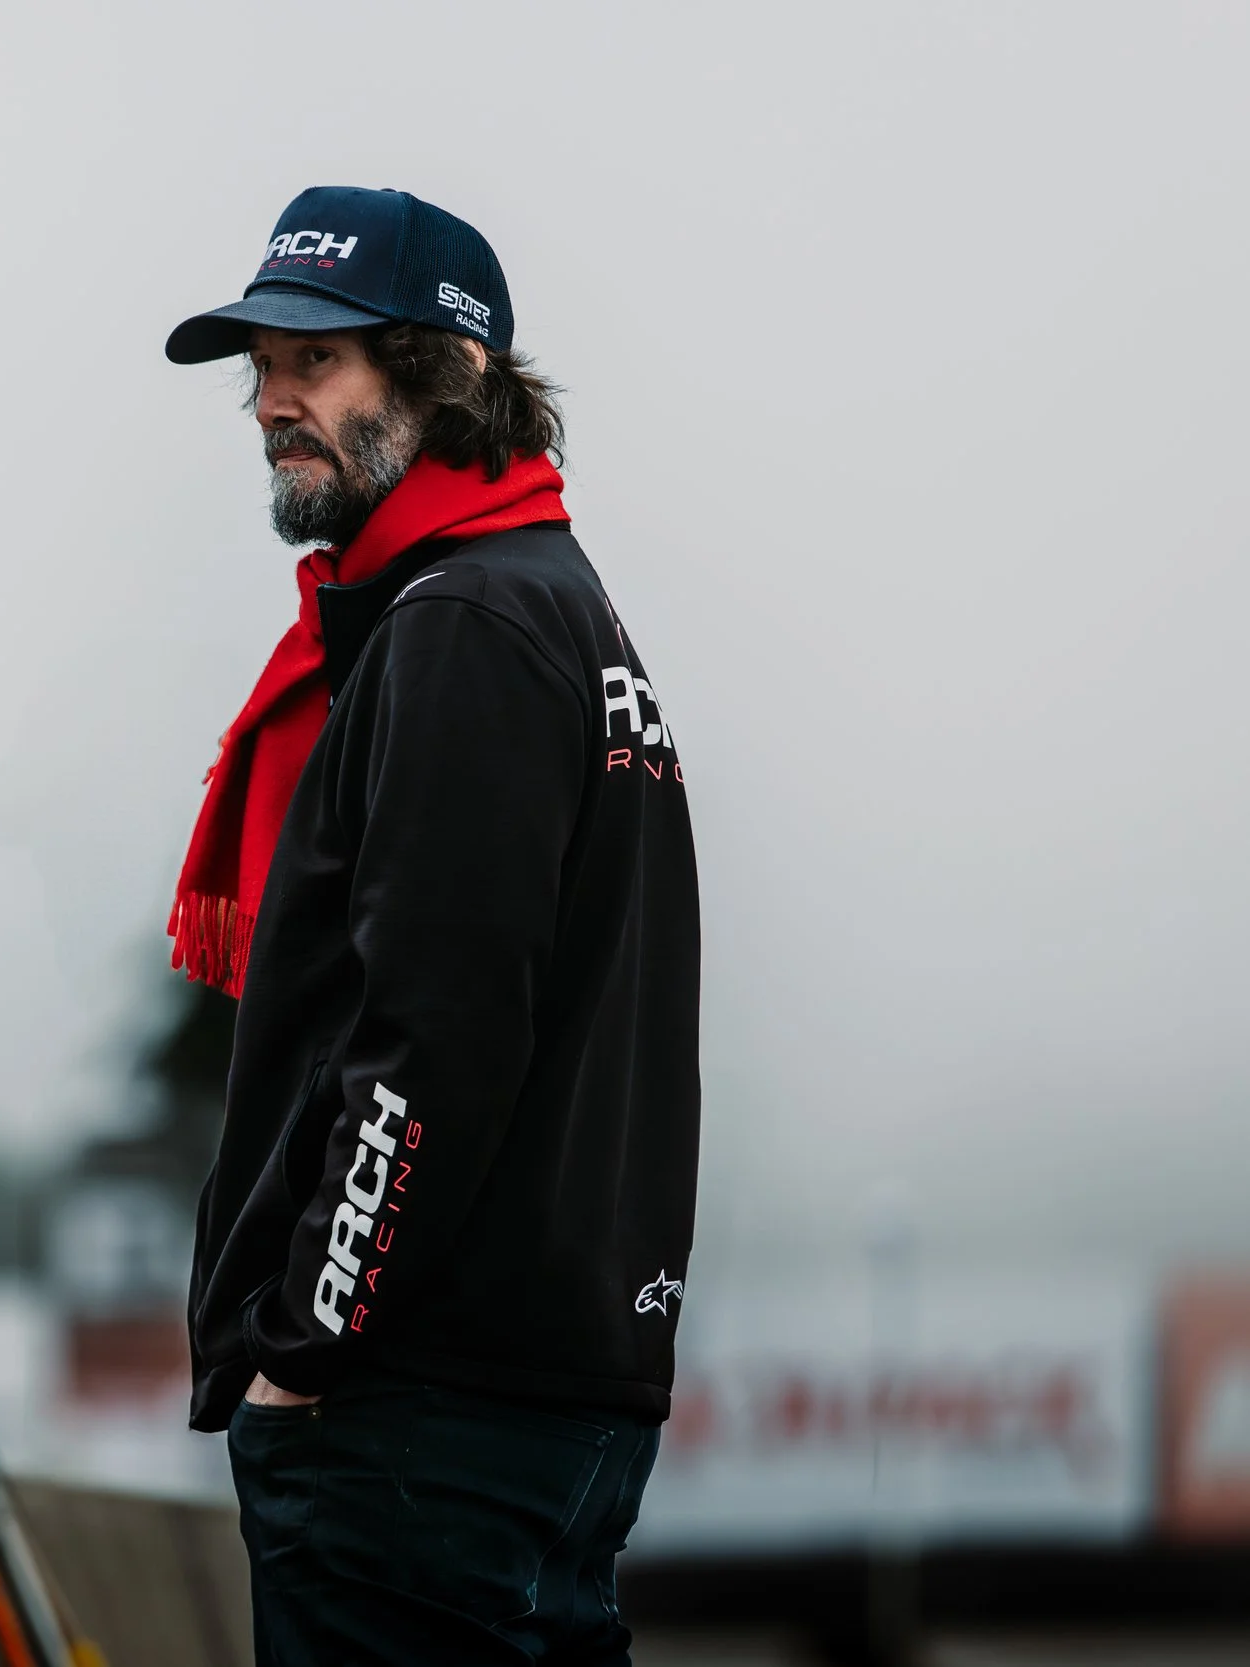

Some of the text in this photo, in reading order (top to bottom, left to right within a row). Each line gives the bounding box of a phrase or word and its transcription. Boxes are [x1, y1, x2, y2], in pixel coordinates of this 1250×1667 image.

[259, 257, 336, 271] CING
[438, 282, 490, 325] SUTER
[455, 312, 489, 338] RACING
[314, 1081, 407, 1336] ARCH
[350, 1119, 422, 1333] RACING
